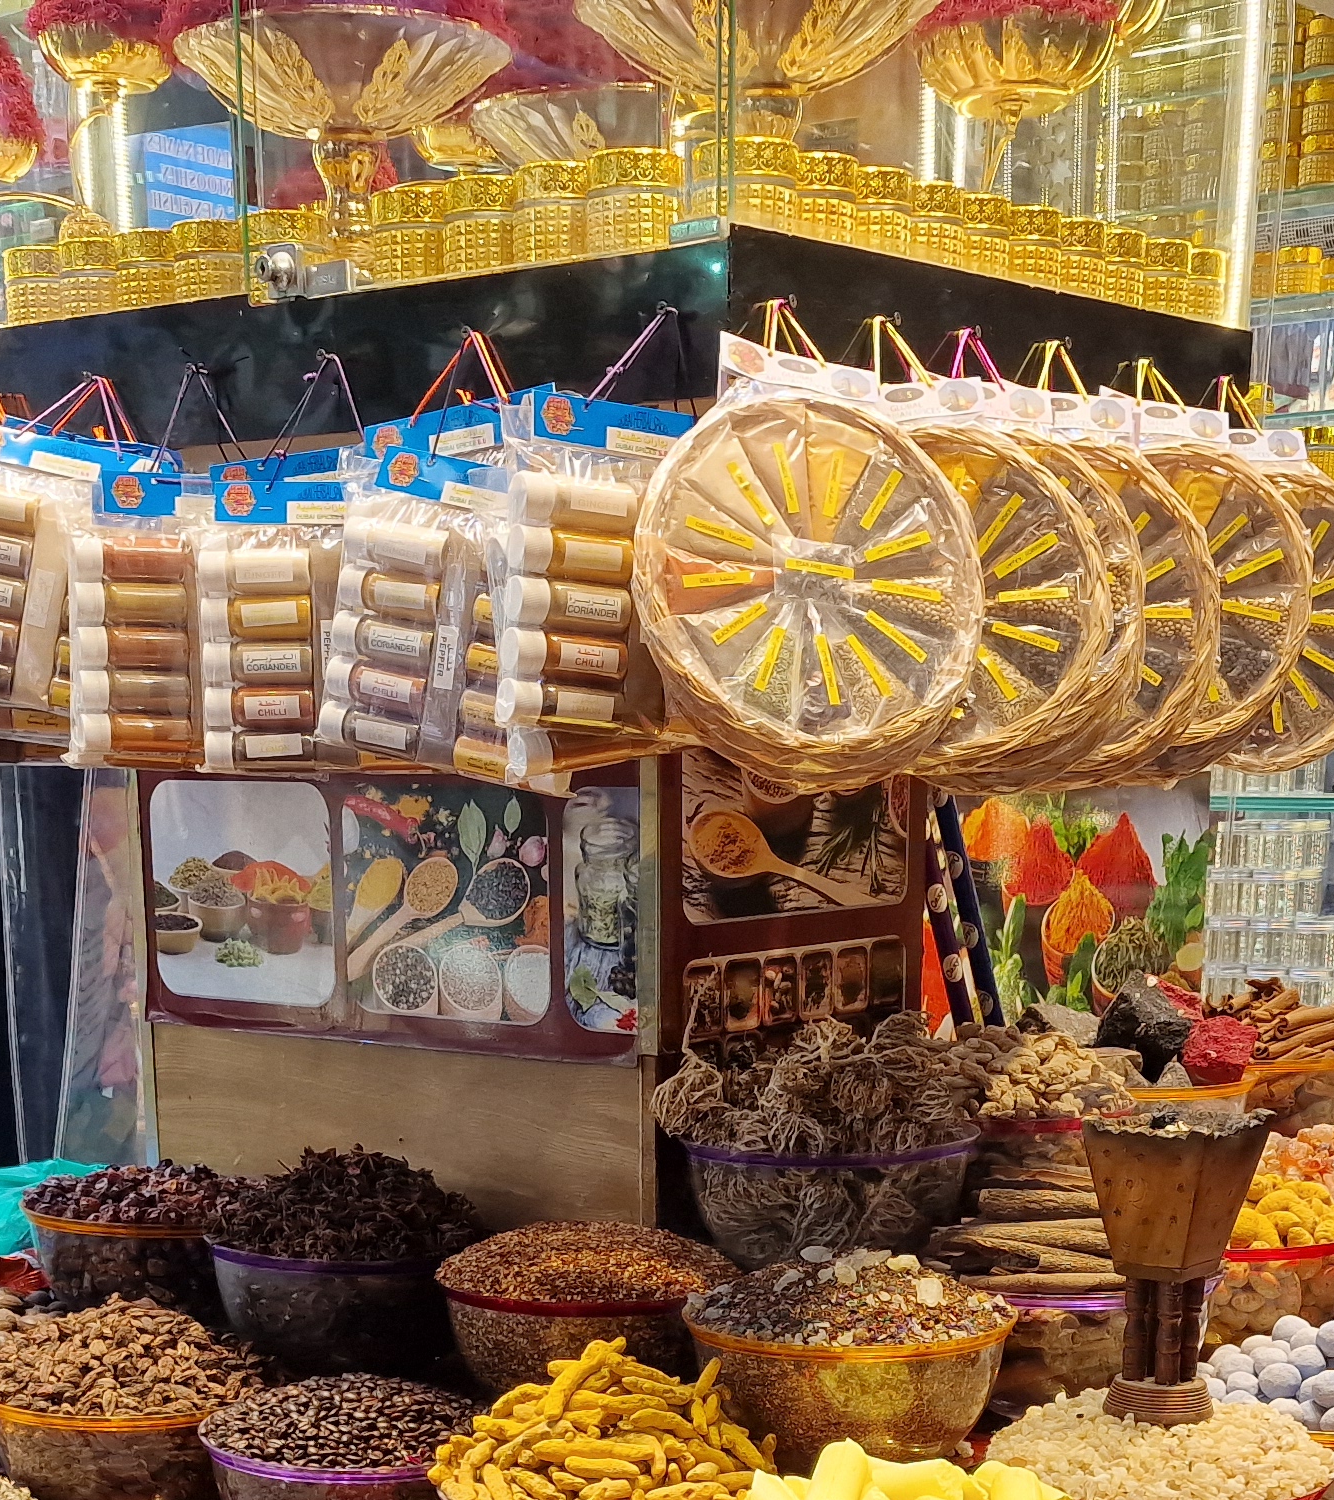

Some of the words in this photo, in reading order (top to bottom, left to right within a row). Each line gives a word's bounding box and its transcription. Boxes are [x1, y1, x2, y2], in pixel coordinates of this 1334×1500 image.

[567, 604, 618, 618] CORIANDER
[715, 627, 730, 640] BLACK
[728, 616, 745, 630] PEPPER
[1018, 633, 1038, 643] PEPPER
[370, 639, 417, 653] CORIANDER
[1038, 640, 1055, 649] BLACK
[436, 636, 448, 678] PEPPER
[575, 657, 605, 668] CHILLI
[246, 663, 298, 672] CORIANDER
[257, 708, 287, 717] CHILLI
